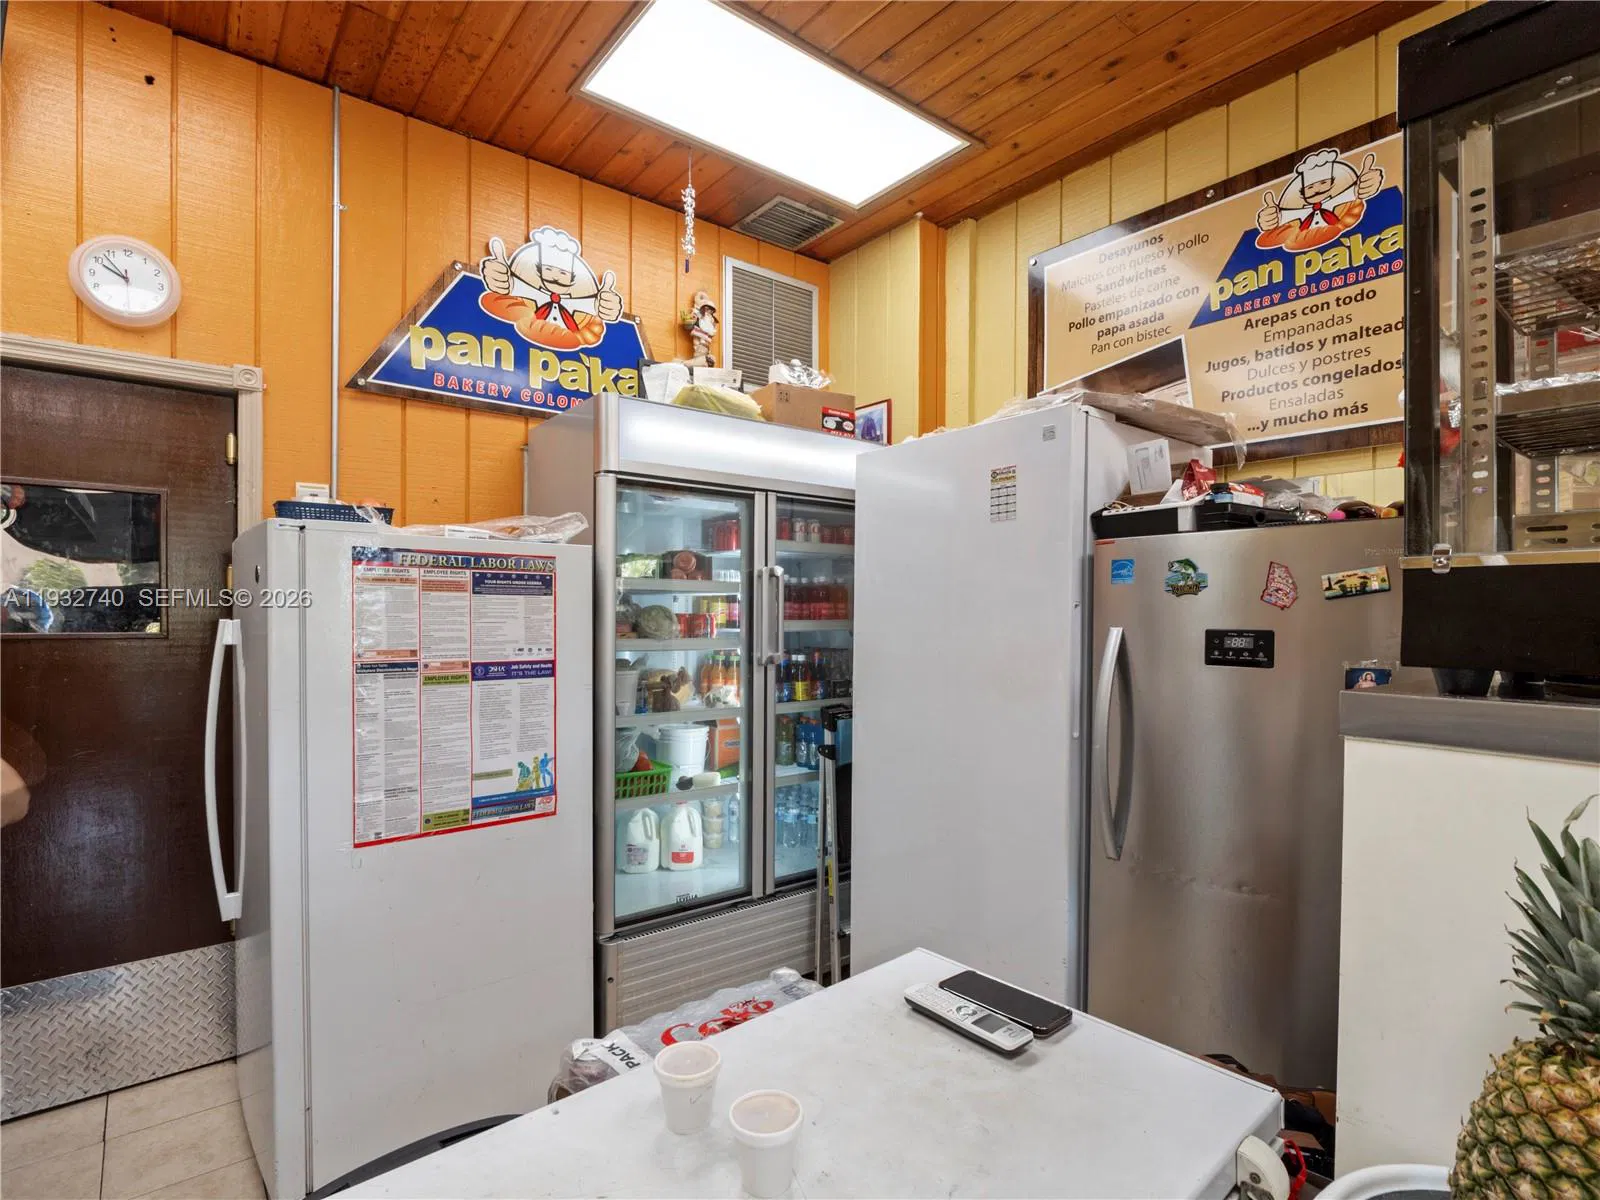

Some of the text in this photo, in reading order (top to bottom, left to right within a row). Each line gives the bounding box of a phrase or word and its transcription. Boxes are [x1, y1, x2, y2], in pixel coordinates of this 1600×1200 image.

[93, 256, 103, 265] 10
[106, 250, 116, 258] 11
[123, 248, 133, 257] 12
[1098, 234, 1164, 264] Desayunos
[1106, 261, 1126, 277] con
[1129, 249, 1165, 272] queso
[1167, 245, 1175, 258] y
[1177, 231, 1210, 254] pollo
[89, 268, 96, 276] 9
[154, 269, 161, 277] 2
[158, 283, 164, 291] 3
[1095, 263, 1167, 295] Sandwiches
[1209, 259, 1283, 311] pan
[1084, 274, 1181, 313] Pasteles de carne
[1224, 259, 1403, 316] BAKERY COLOMBIANO
[1068, 284, 1200, 332] Pollo empanizado con
[1244, 288, 1377, 331] Arepas con todo
[1090, 324, 1172, 355] Pan con bistec
[1096, 311, 1165, 340] papa asada
[1264, 312, 1353, 343] Empanadas
[409, 325, 639, 397] pan pa'ka
[1205, 356, 1250, 374] Jugos,
[1255, 339, 1314, 362] batidos
[1318, 338, 1328, 351] y
[1247, 345, 1371, 381] Dulces y postres
[433, 372, 512, 398] BAKERY
[1221, 378, 1298, 402] Productos
[1268, 387, 1344, 411] Ensaladas
[1273, 409, 1329, 428] mucho
[1333, 402, 1369, 418] más
[400, 554, 554, 571] FEDERAL LABOR LAWS
